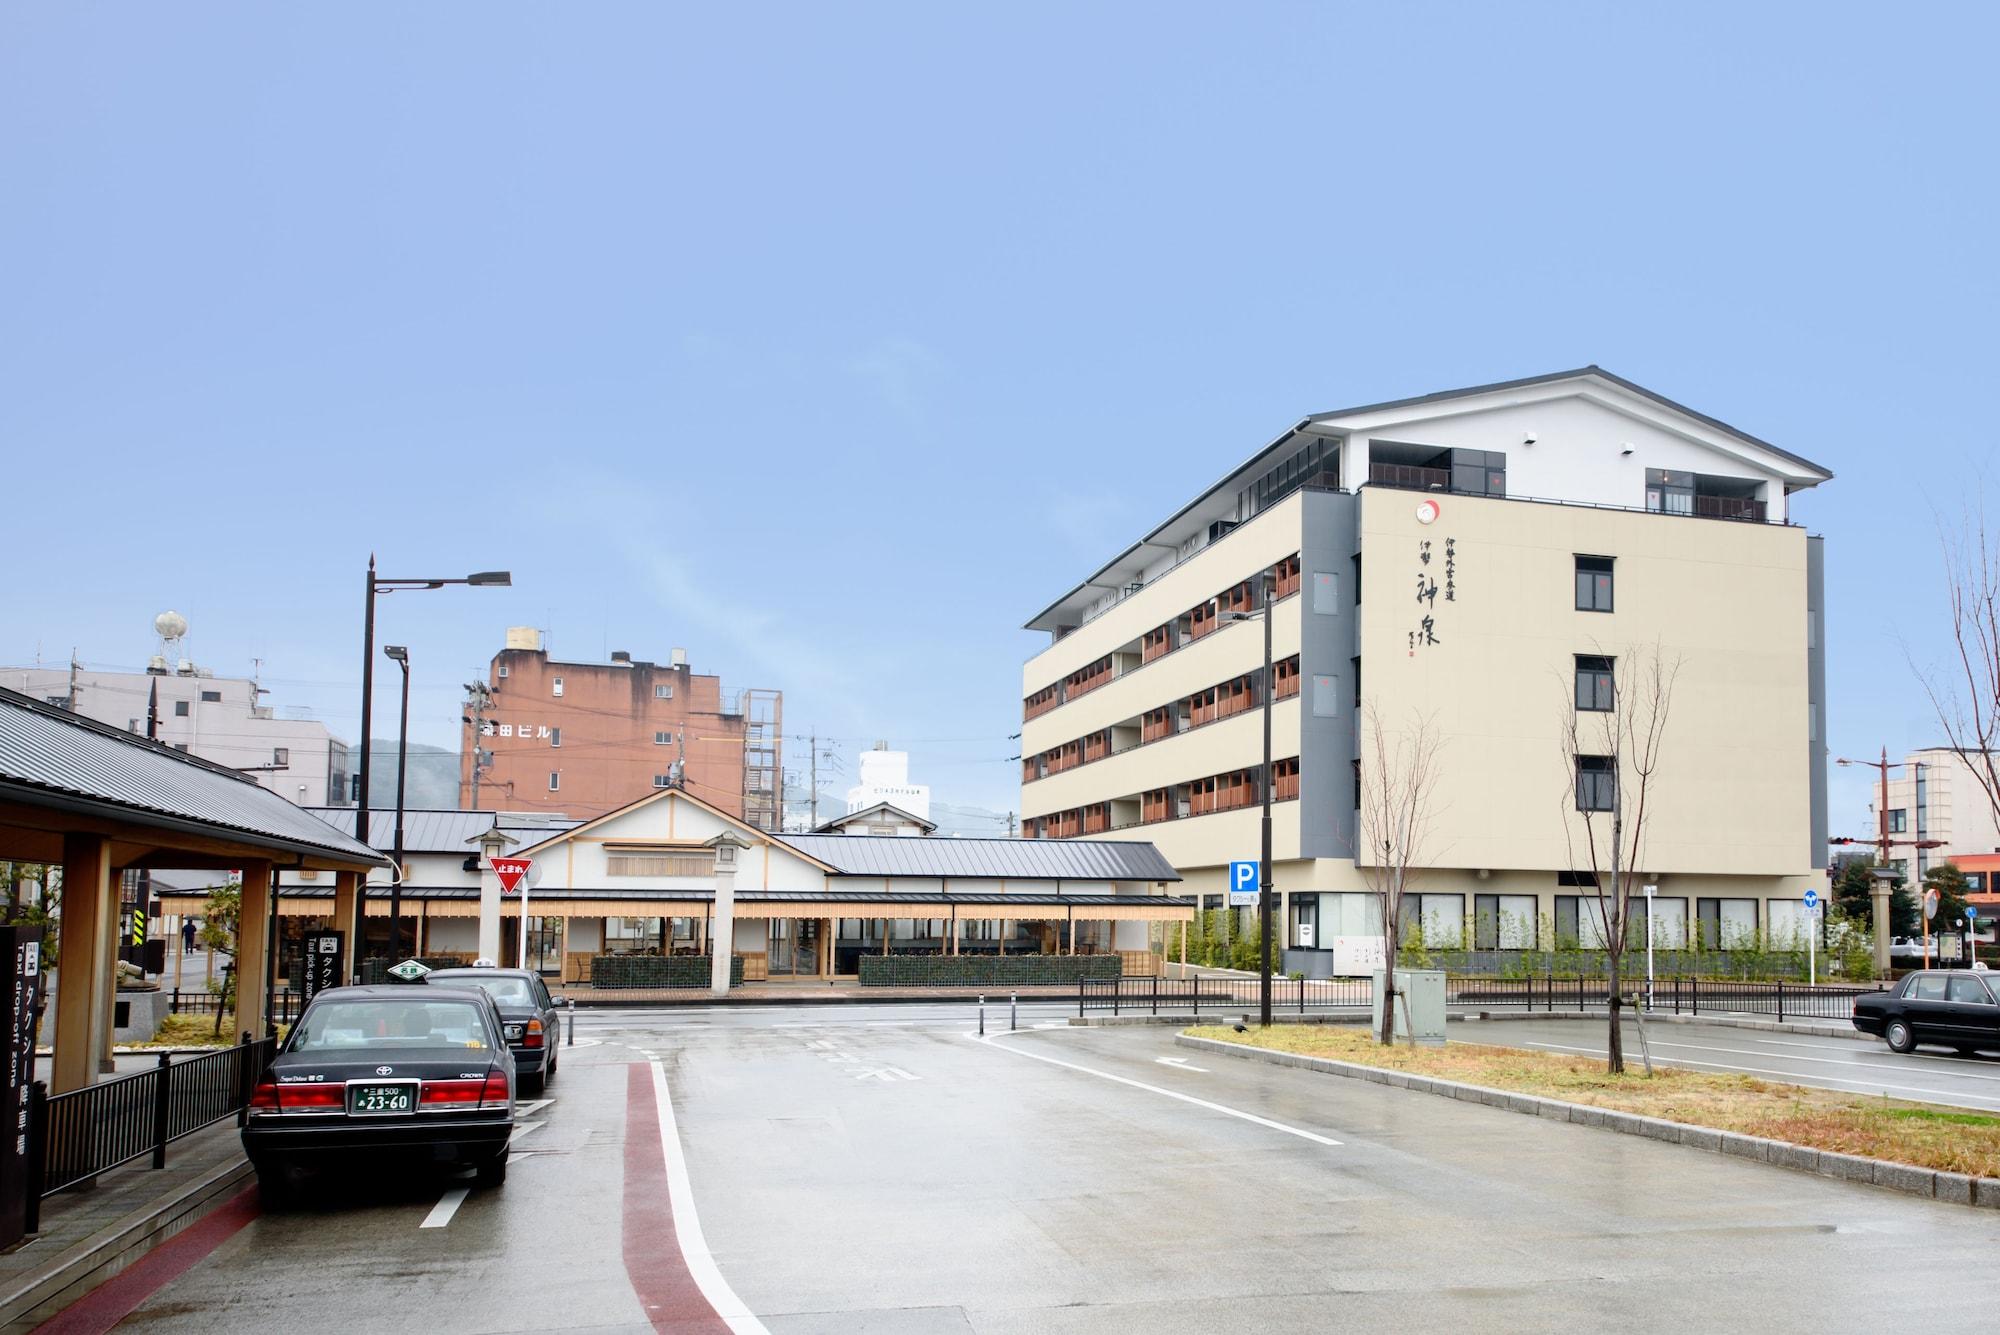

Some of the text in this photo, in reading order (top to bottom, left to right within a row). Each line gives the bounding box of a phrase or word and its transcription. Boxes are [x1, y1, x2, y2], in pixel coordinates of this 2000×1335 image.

[1445, 537, 1456, 602] 伊勢外宮参道
[497, 864, 523, 874] 止まれ
[1237, 864, 1254, 890] P
[305, 938, 317, 999] Taxi pick-up zone
[10, 943, 25, 1088] Taxi drop-off zone
[16, 985, 34, 1155] タクシー降車場
[366, 1095, 408, 1110] 23-60
